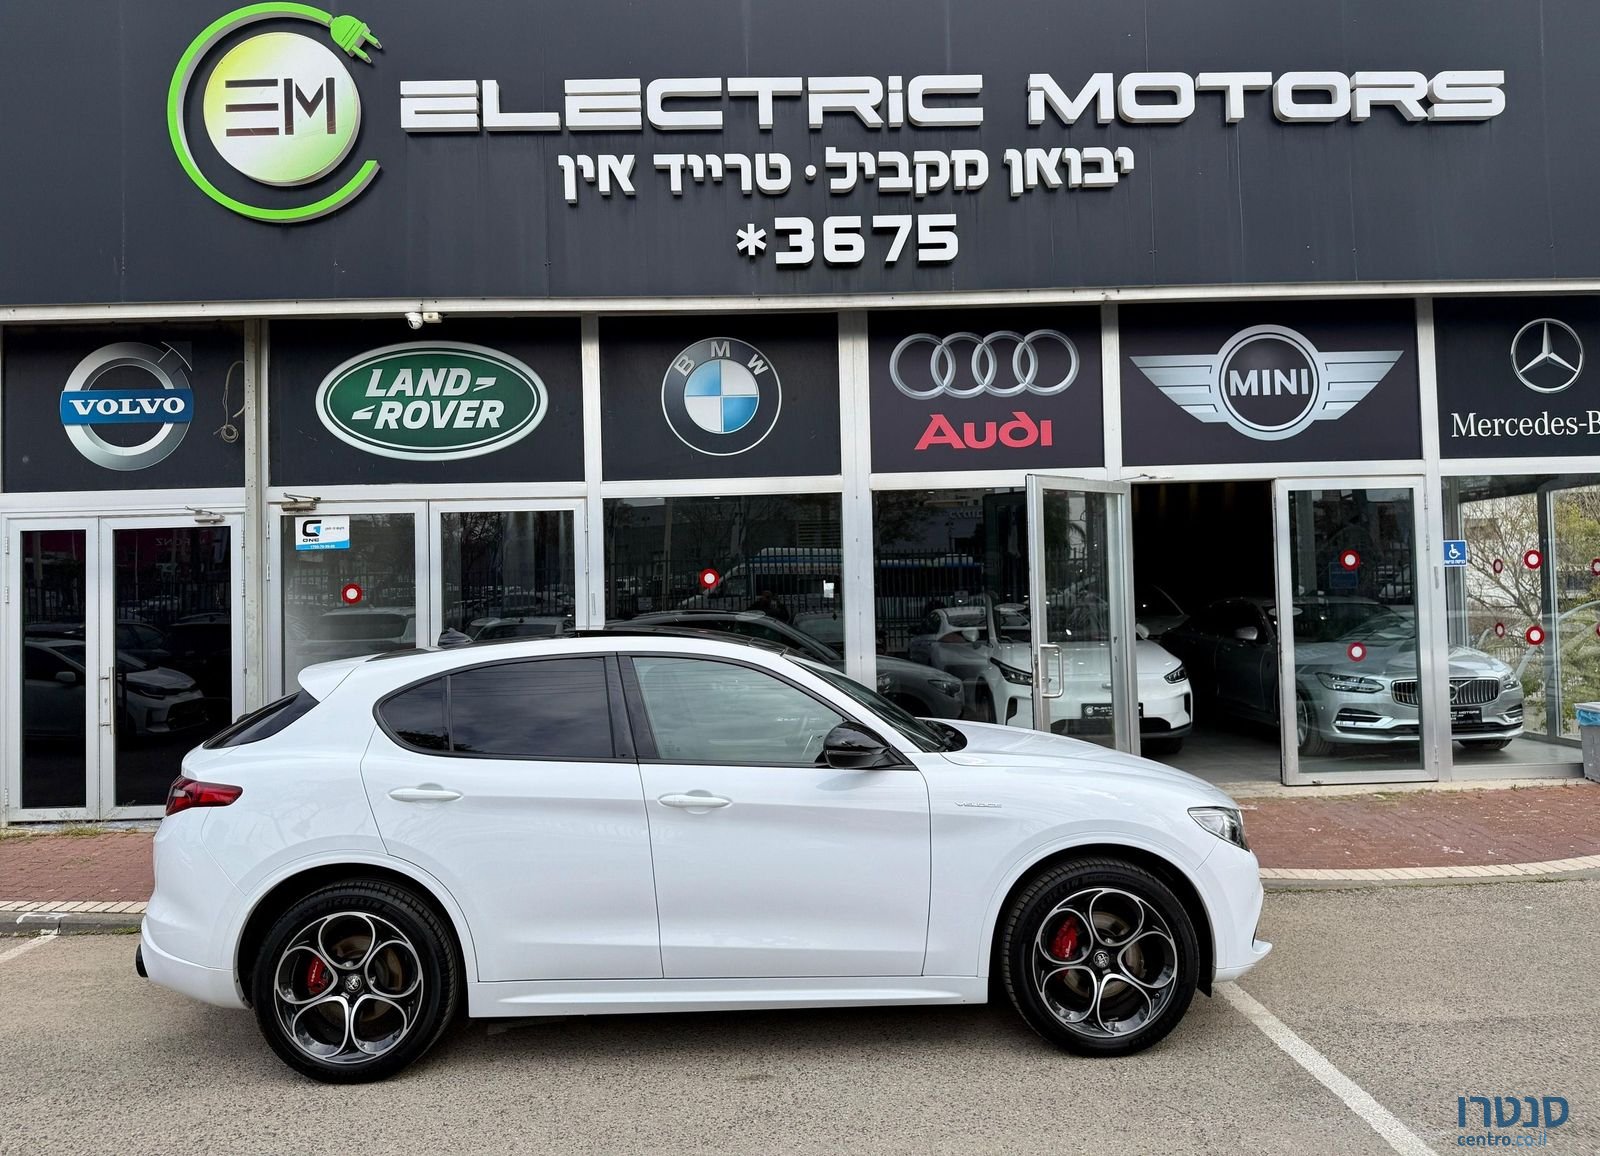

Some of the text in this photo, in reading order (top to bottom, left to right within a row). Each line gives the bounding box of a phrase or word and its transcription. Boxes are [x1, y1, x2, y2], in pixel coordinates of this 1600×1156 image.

[1028, 70, 1506, 125] MOTORS
[557, 146, 1135, 204] יבואן מקביל טרייד אין
[365, 367, 471, 397] LAND
[1228, 366, 1311, 398] MINI
[69, 396, 186, 416] VOLVO
[374, 400, 505, 430] ROVER
[914, 411, 1053, 450] Audi
